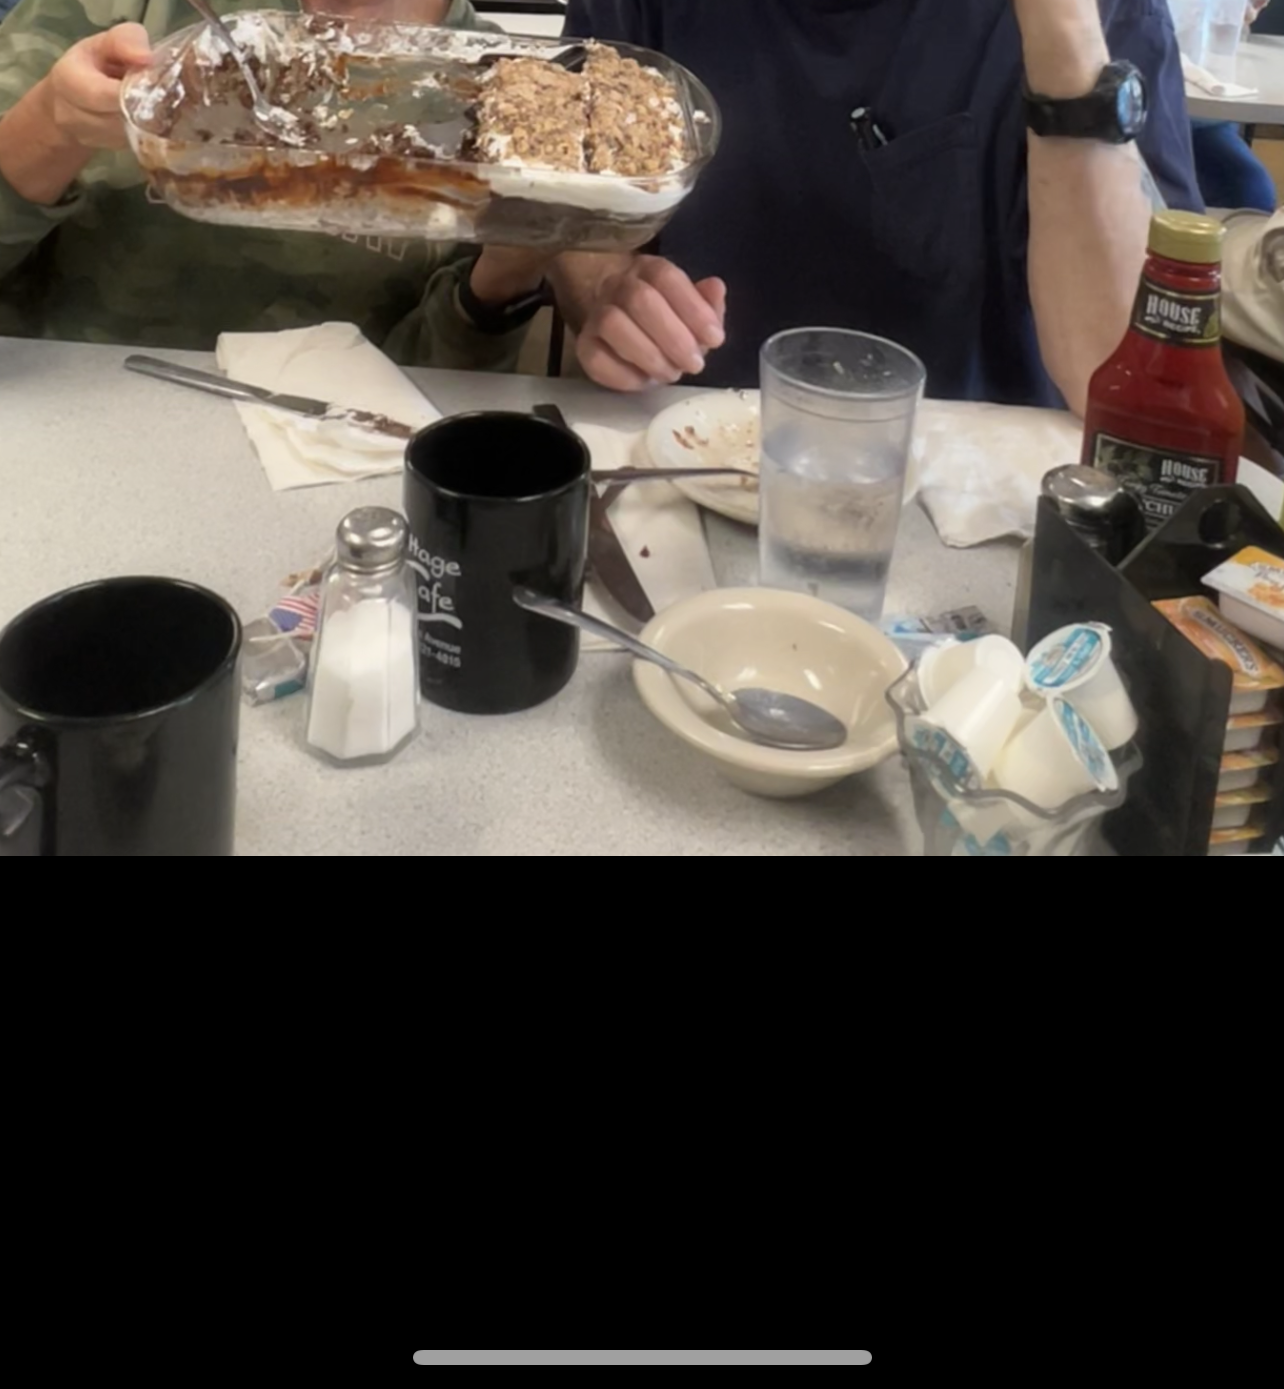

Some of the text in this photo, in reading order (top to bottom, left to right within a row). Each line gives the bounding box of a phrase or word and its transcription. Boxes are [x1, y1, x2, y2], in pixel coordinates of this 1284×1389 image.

[1146, 294, 1202, 326] HOUSE
[1160, 459, 1208, 483] HOUSE
[408, 533, 461, 578] ttage
